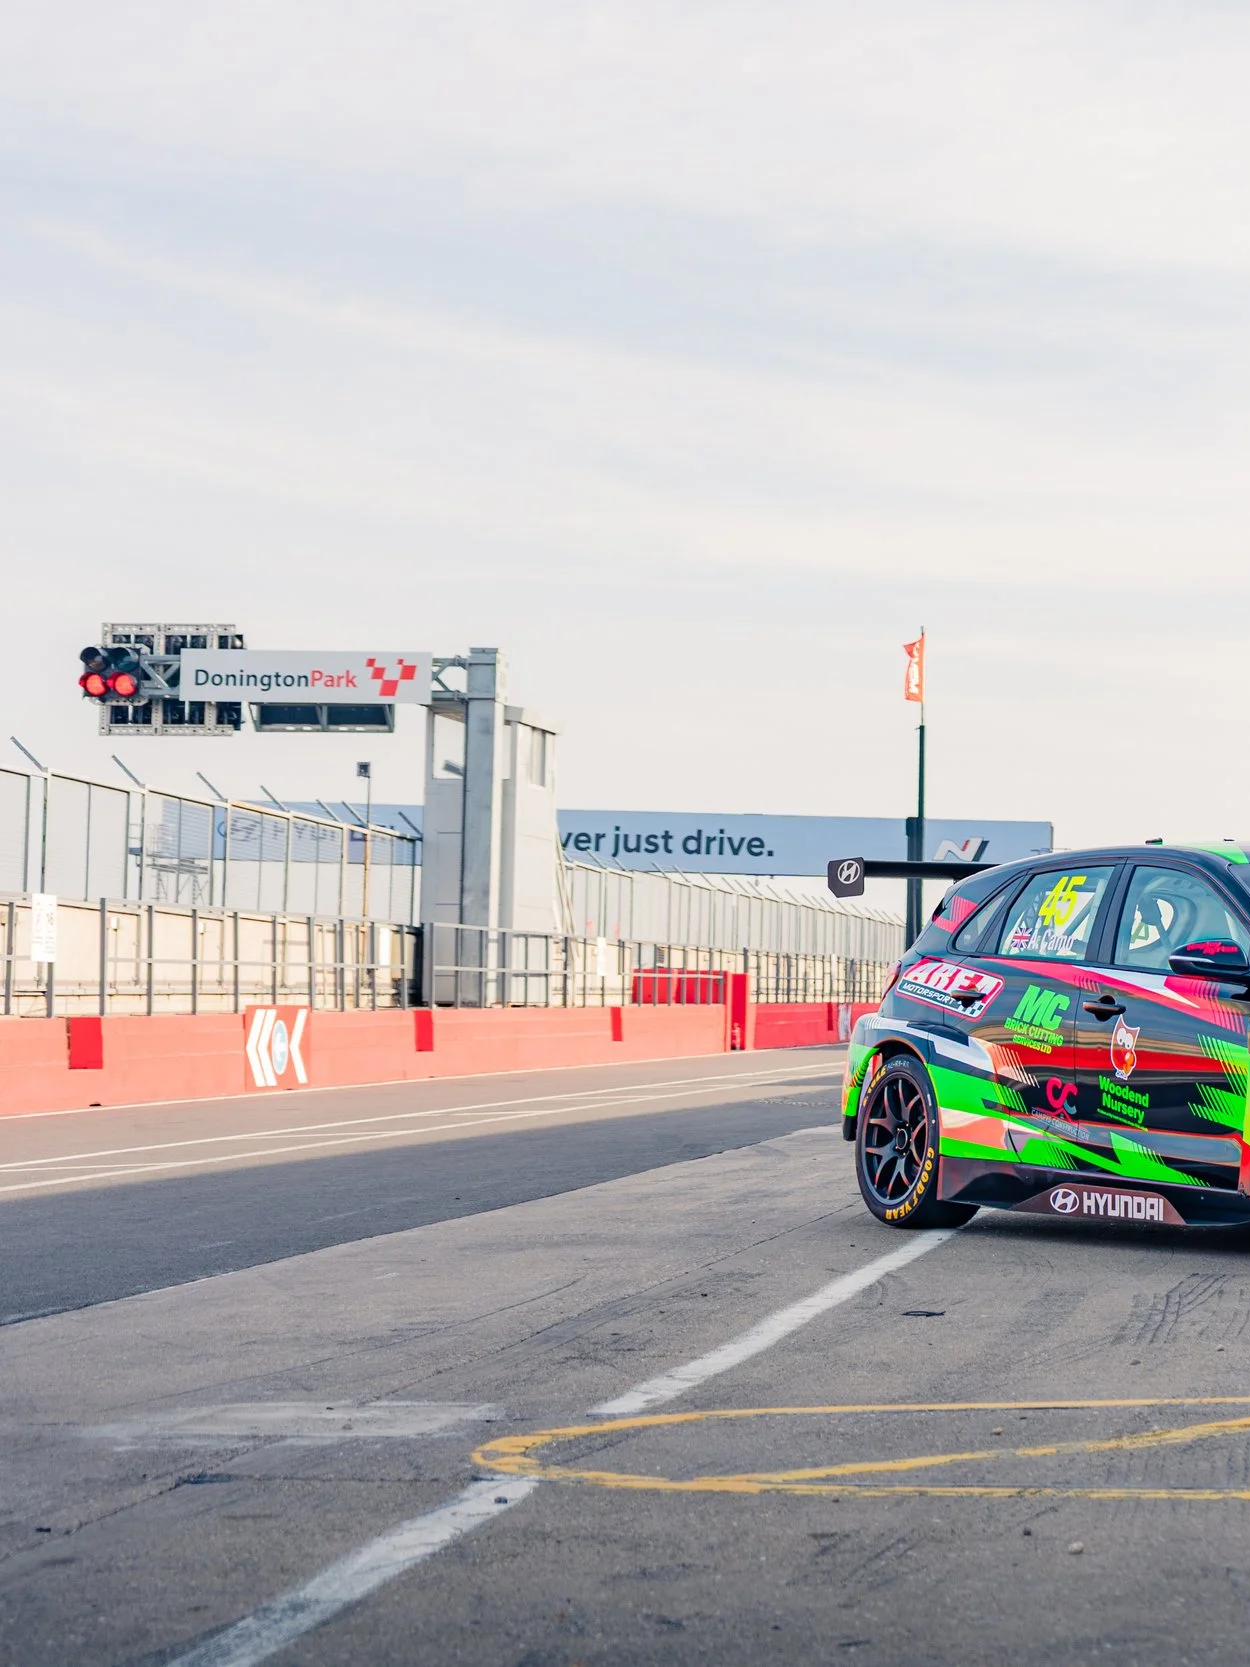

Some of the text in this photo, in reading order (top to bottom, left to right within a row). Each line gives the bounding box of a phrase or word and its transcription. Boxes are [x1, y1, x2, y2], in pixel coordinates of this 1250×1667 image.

[194, 669, 358, 691] DoningtonPark
[612, 826, 673, 857] just
[682, 829, 774, 857] drive.
[1038, 876, 1087, 926] 45
[902, 982, 957, 1004] MOTORSPORT
[1013, 985, 1070, 1031] MC
[1004, 1017, 1064, 1046] BRICK CUTTING
[1040, 1043, 1052, 1054] LTD
[1099, 1075, 1149, 1108] Woodend
[1102, 1093, 1145, 1123] Nursery
[1050, 1118, 1090, 1140] CONSTRUCTION
[1083, 1191, 1164, 1221] HYUNDAI
